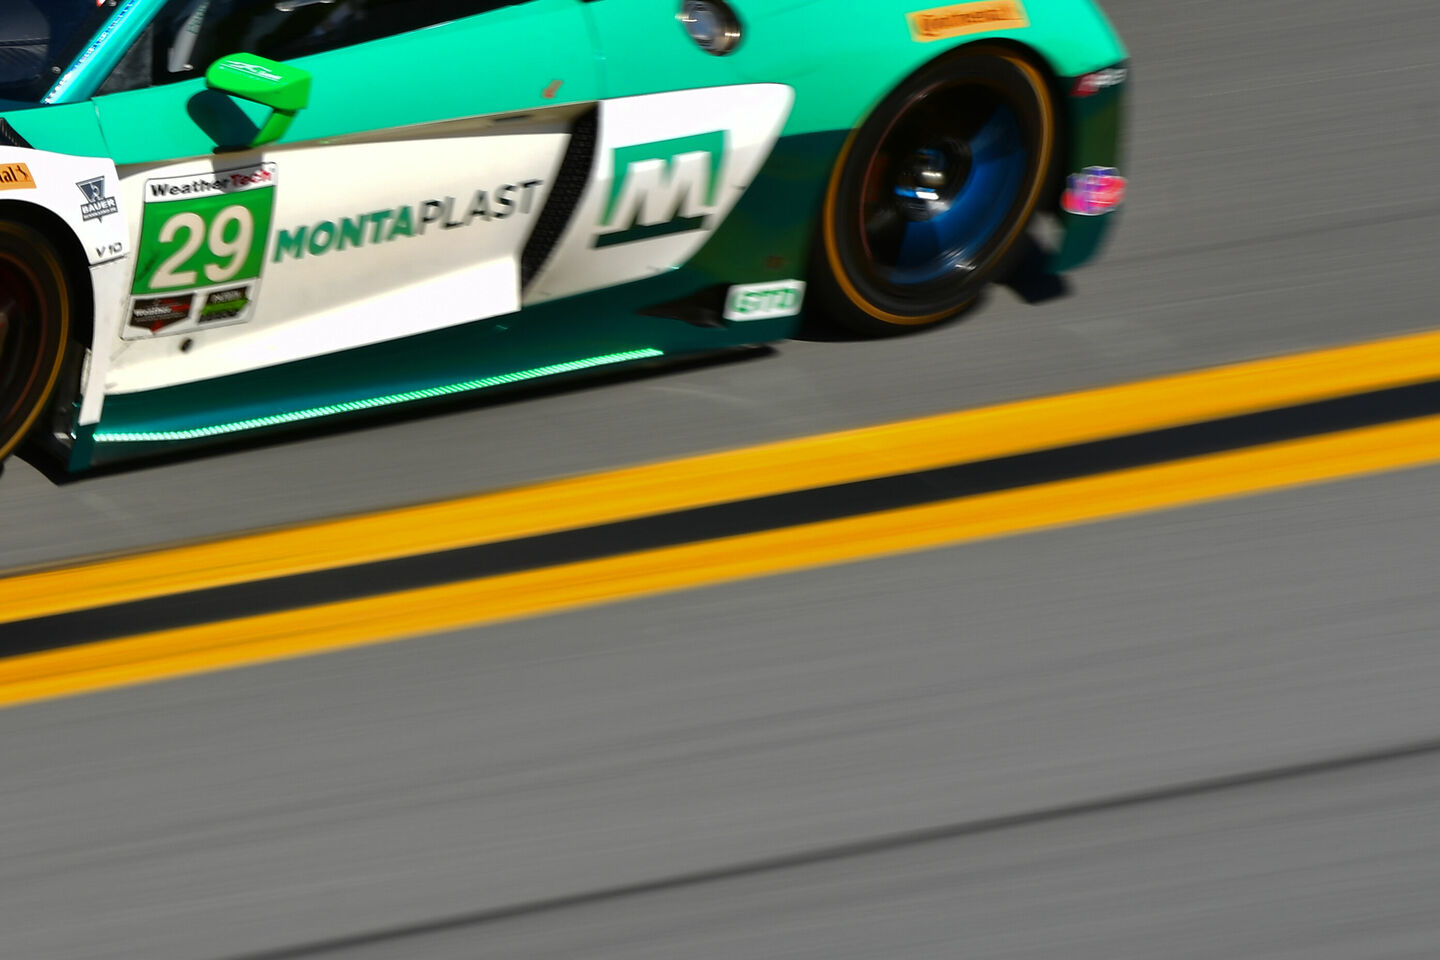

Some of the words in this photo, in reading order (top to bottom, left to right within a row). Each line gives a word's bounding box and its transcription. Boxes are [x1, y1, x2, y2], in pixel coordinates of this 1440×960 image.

[82, 199, 116, 214] BAUER
[150, 169, 272, 197] WeatherTech
[271, 179, 544, 263] MONTAPLAST
[603, 150, 716, 233] M
[148, 204, 254, 289] 29
